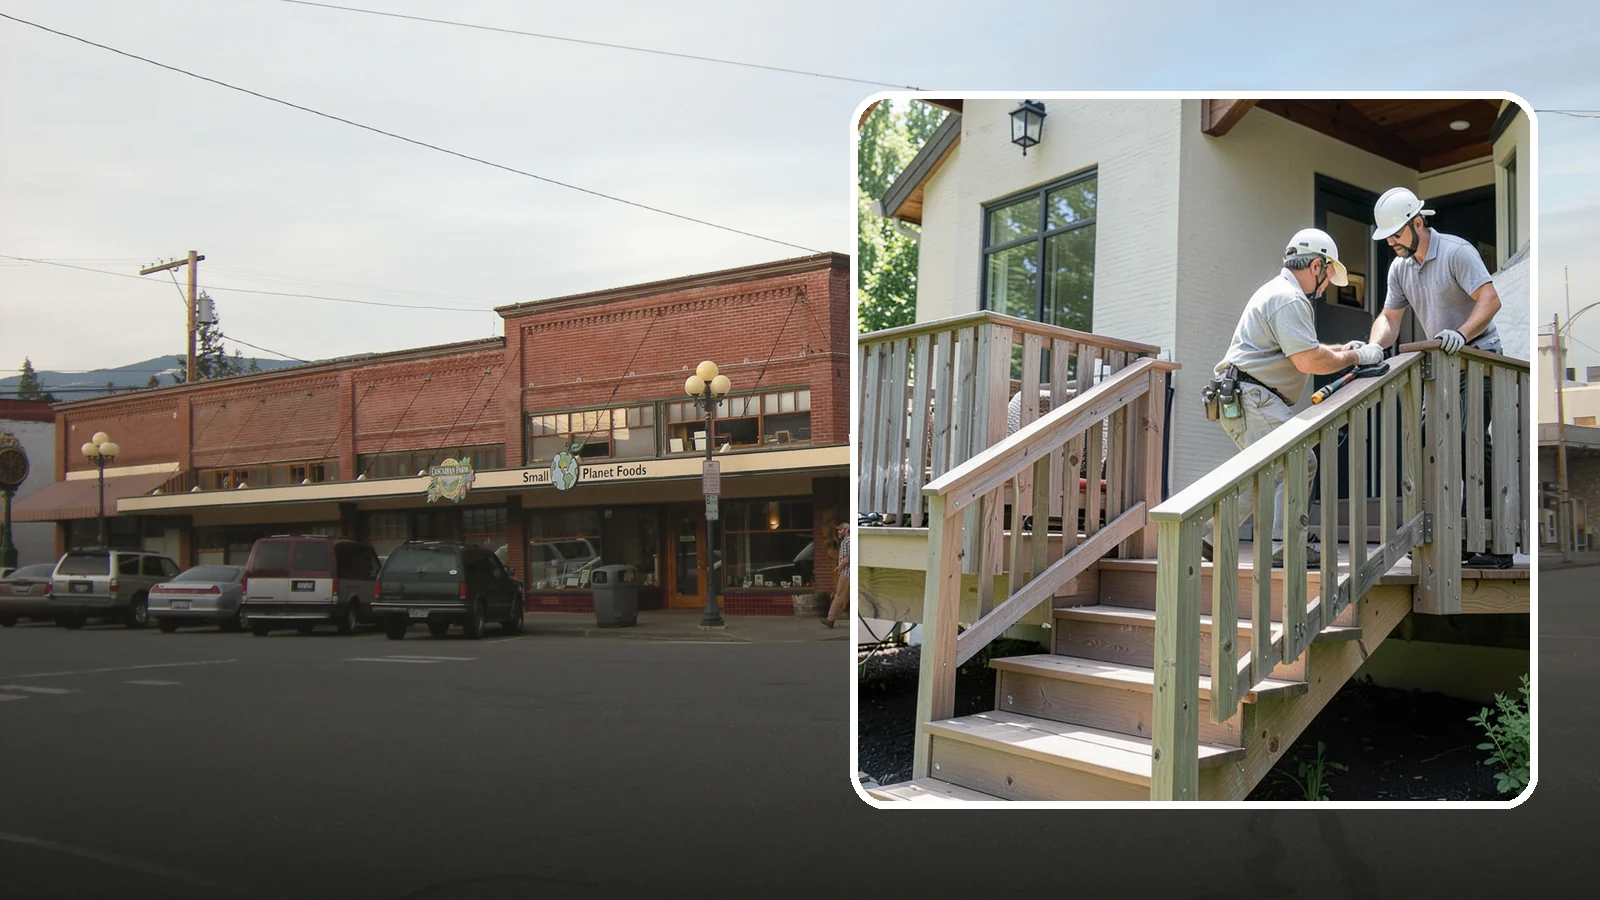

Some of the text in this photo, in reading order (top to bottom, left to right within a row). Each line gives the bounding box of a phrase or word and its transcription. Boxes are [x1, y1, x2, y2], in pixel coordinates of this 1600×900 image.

[523, 464, 647, 483] Small Planet Foods
